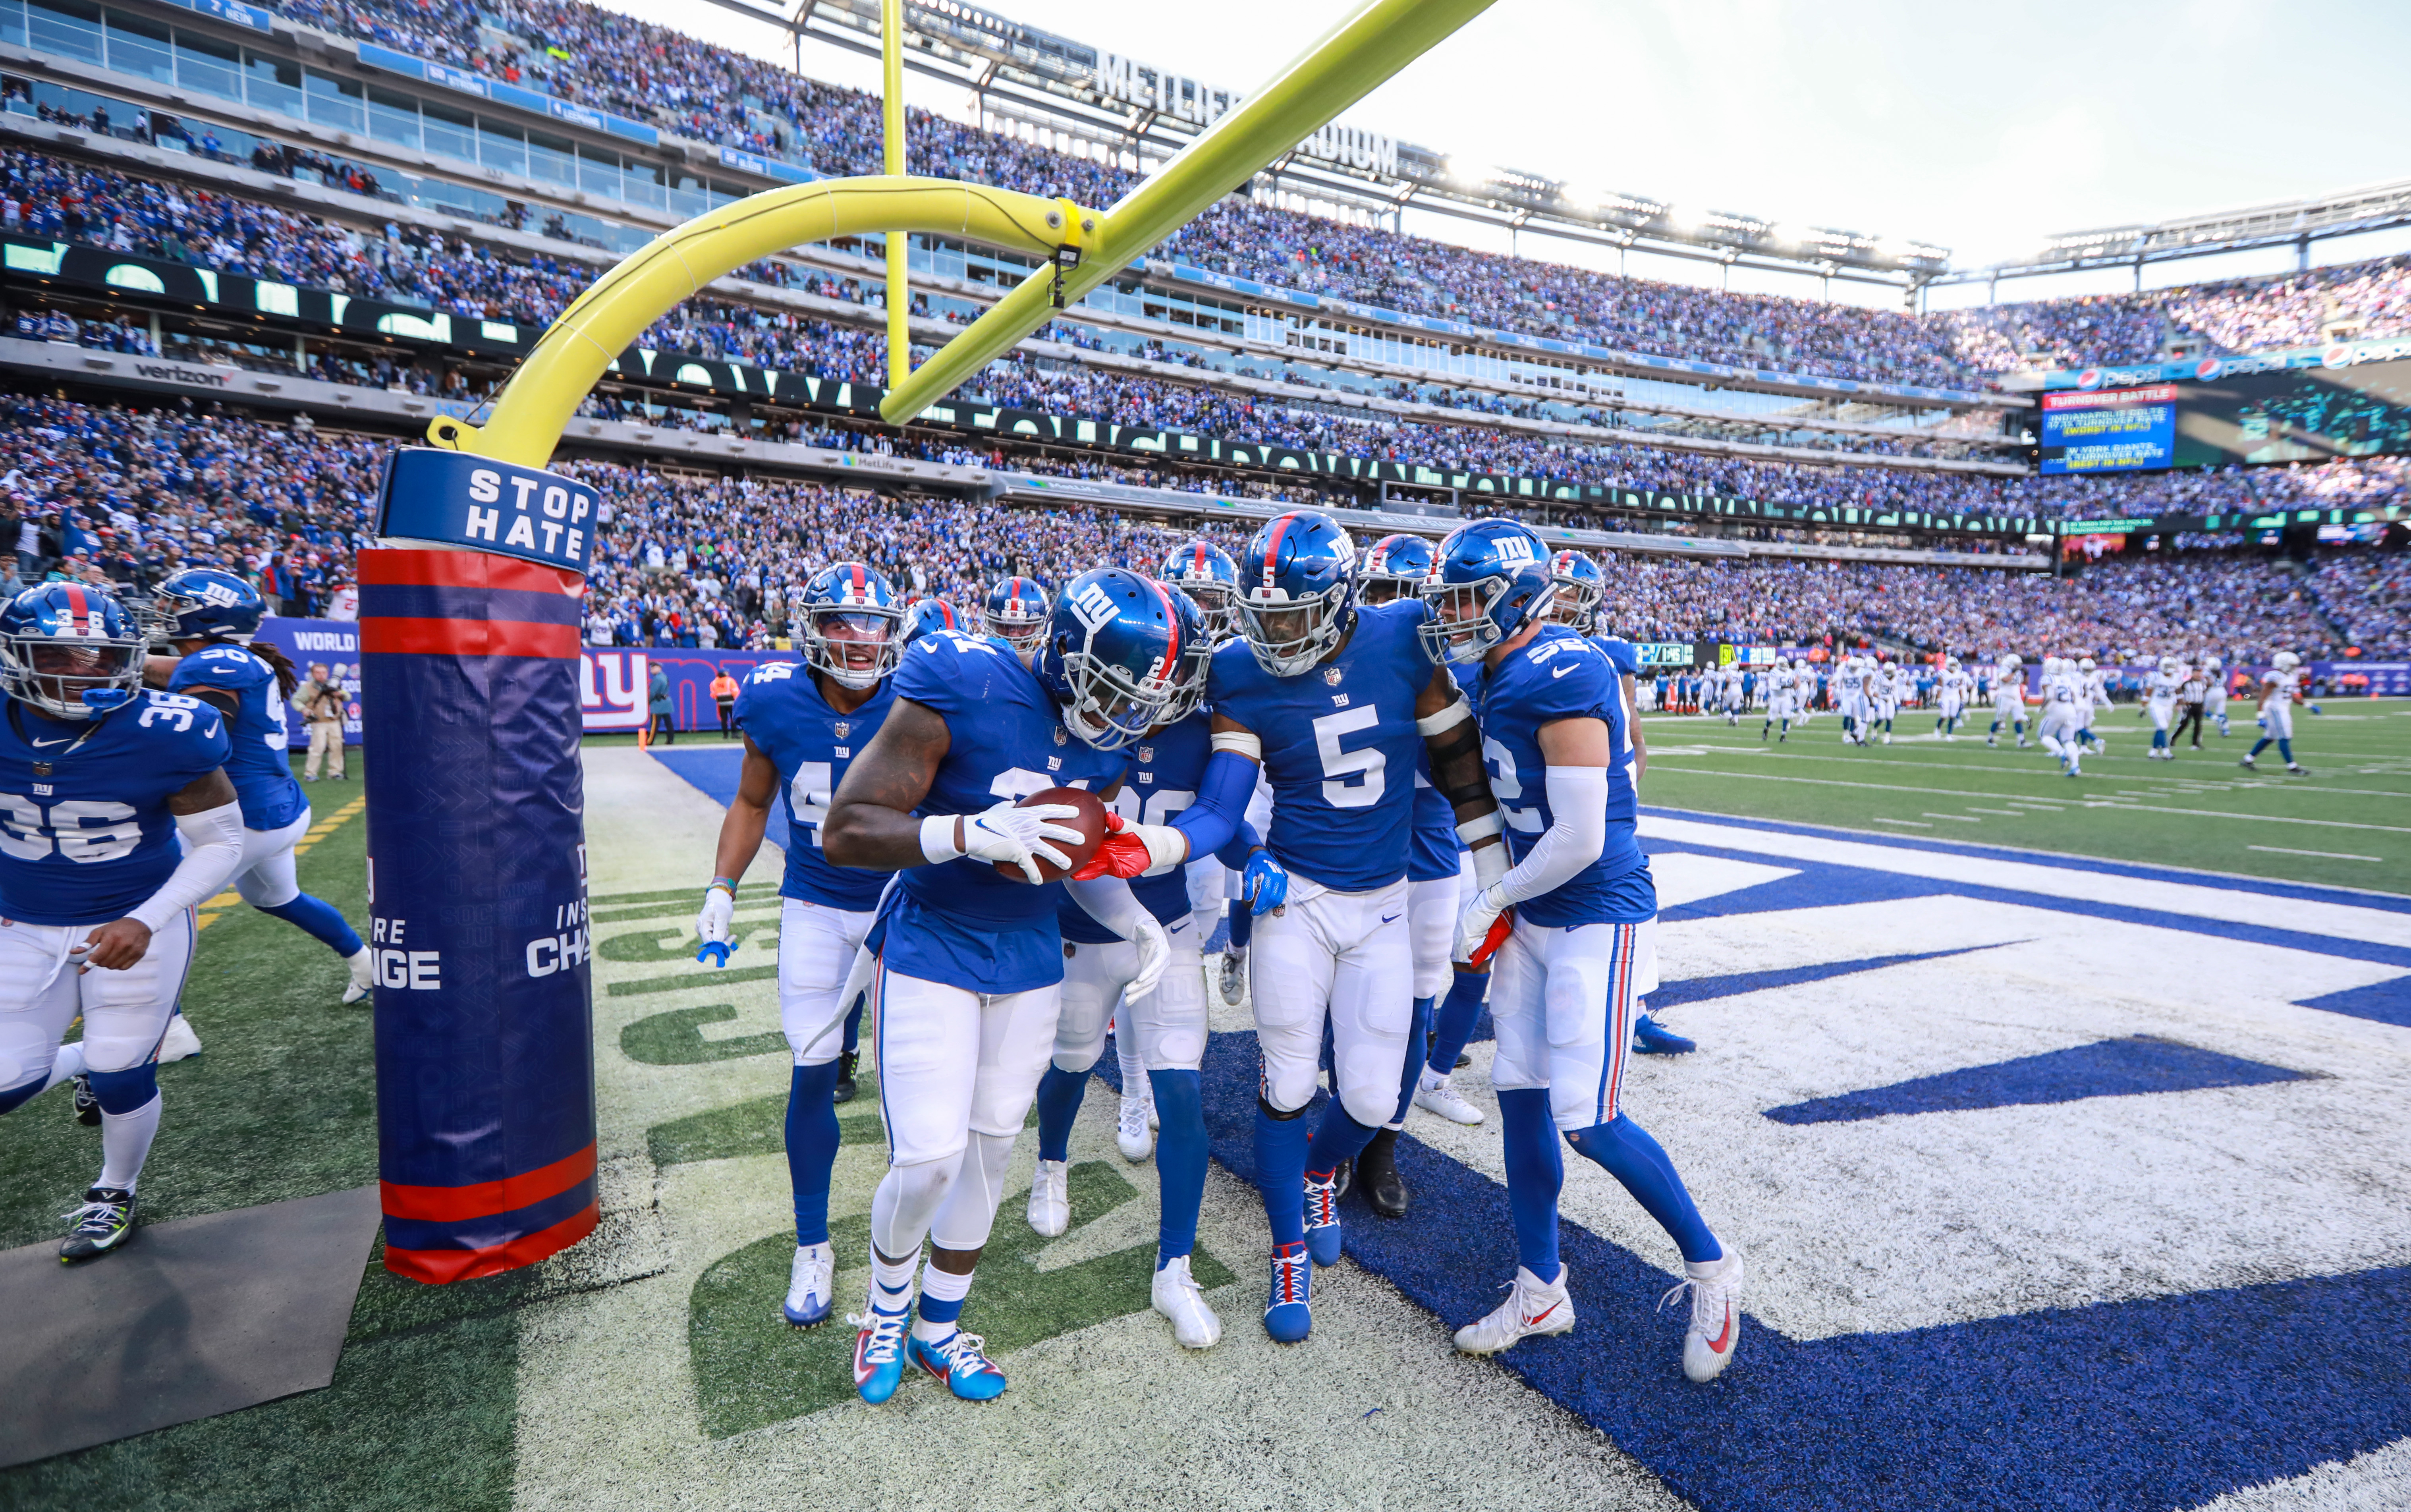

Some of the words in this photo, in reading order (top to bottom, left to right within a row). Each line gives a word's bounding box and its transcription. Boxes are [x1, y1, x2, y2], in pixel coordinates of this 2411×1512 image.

[225, 7, 254, 27] HEIN
[1297, 121, 1399, 177] ADIUM
[134, 363, 224, 387] verizon
[2222, 354, 2287, 378] pepsi
[2102, 366, 2161, 390] pepsi
[2049, 392, 2117, 407] TURNOVER
[2119, 388, 2171, 402] BATTLE
[2049, 409, 2126, 422] INDIANAPOLIS
[859, 458, 894, 469] MetLife
[469, 468, 589, 525] STOP
[1234, 502, 1279, 511] MetLife
[1376, 516, 1427, 526] METLIFE
[1426, 520, 1464, 528] STADIU
[465, 505, 583, 561] HATE
[1491, 536, 1535, 570] ny
[1186, 559, 1212, 573] 54
[1262, 566, 1275, 588] 5
[201, 581, 240, 608] ny
[842, 579, 876, 597] 44
[1004, 598, 1025, 611] 99
[1070, 582, 1121, 635] ny
[56, 608, 105, 629] 36
[293, 631, 356, 652] WORLD
[1527, 638, 1591, 664] 52
[1662, 647, 1680, 662] 1:45
[1749, 647, 1761, 664] 20
[1147, 655, 1178, 680] 21
[1328, 674, 1339, 683] NFL
[1331, 693, 1349, 707] ny
[138, 691, 200, 732] 36
[834, 746, 849, 759] ny
[1047, 755, 1062, 771] ny
[1312, 703, 1386, 808] 5
[1137, 771, 1152, 784] ny
[1483, 735, 1544, 833] 2
[32, 783, 53, 796] ny
[790, 761, 831, 846] 4
[0, 792, 143, 863] 36
[557, 904, 587, 930] INS
